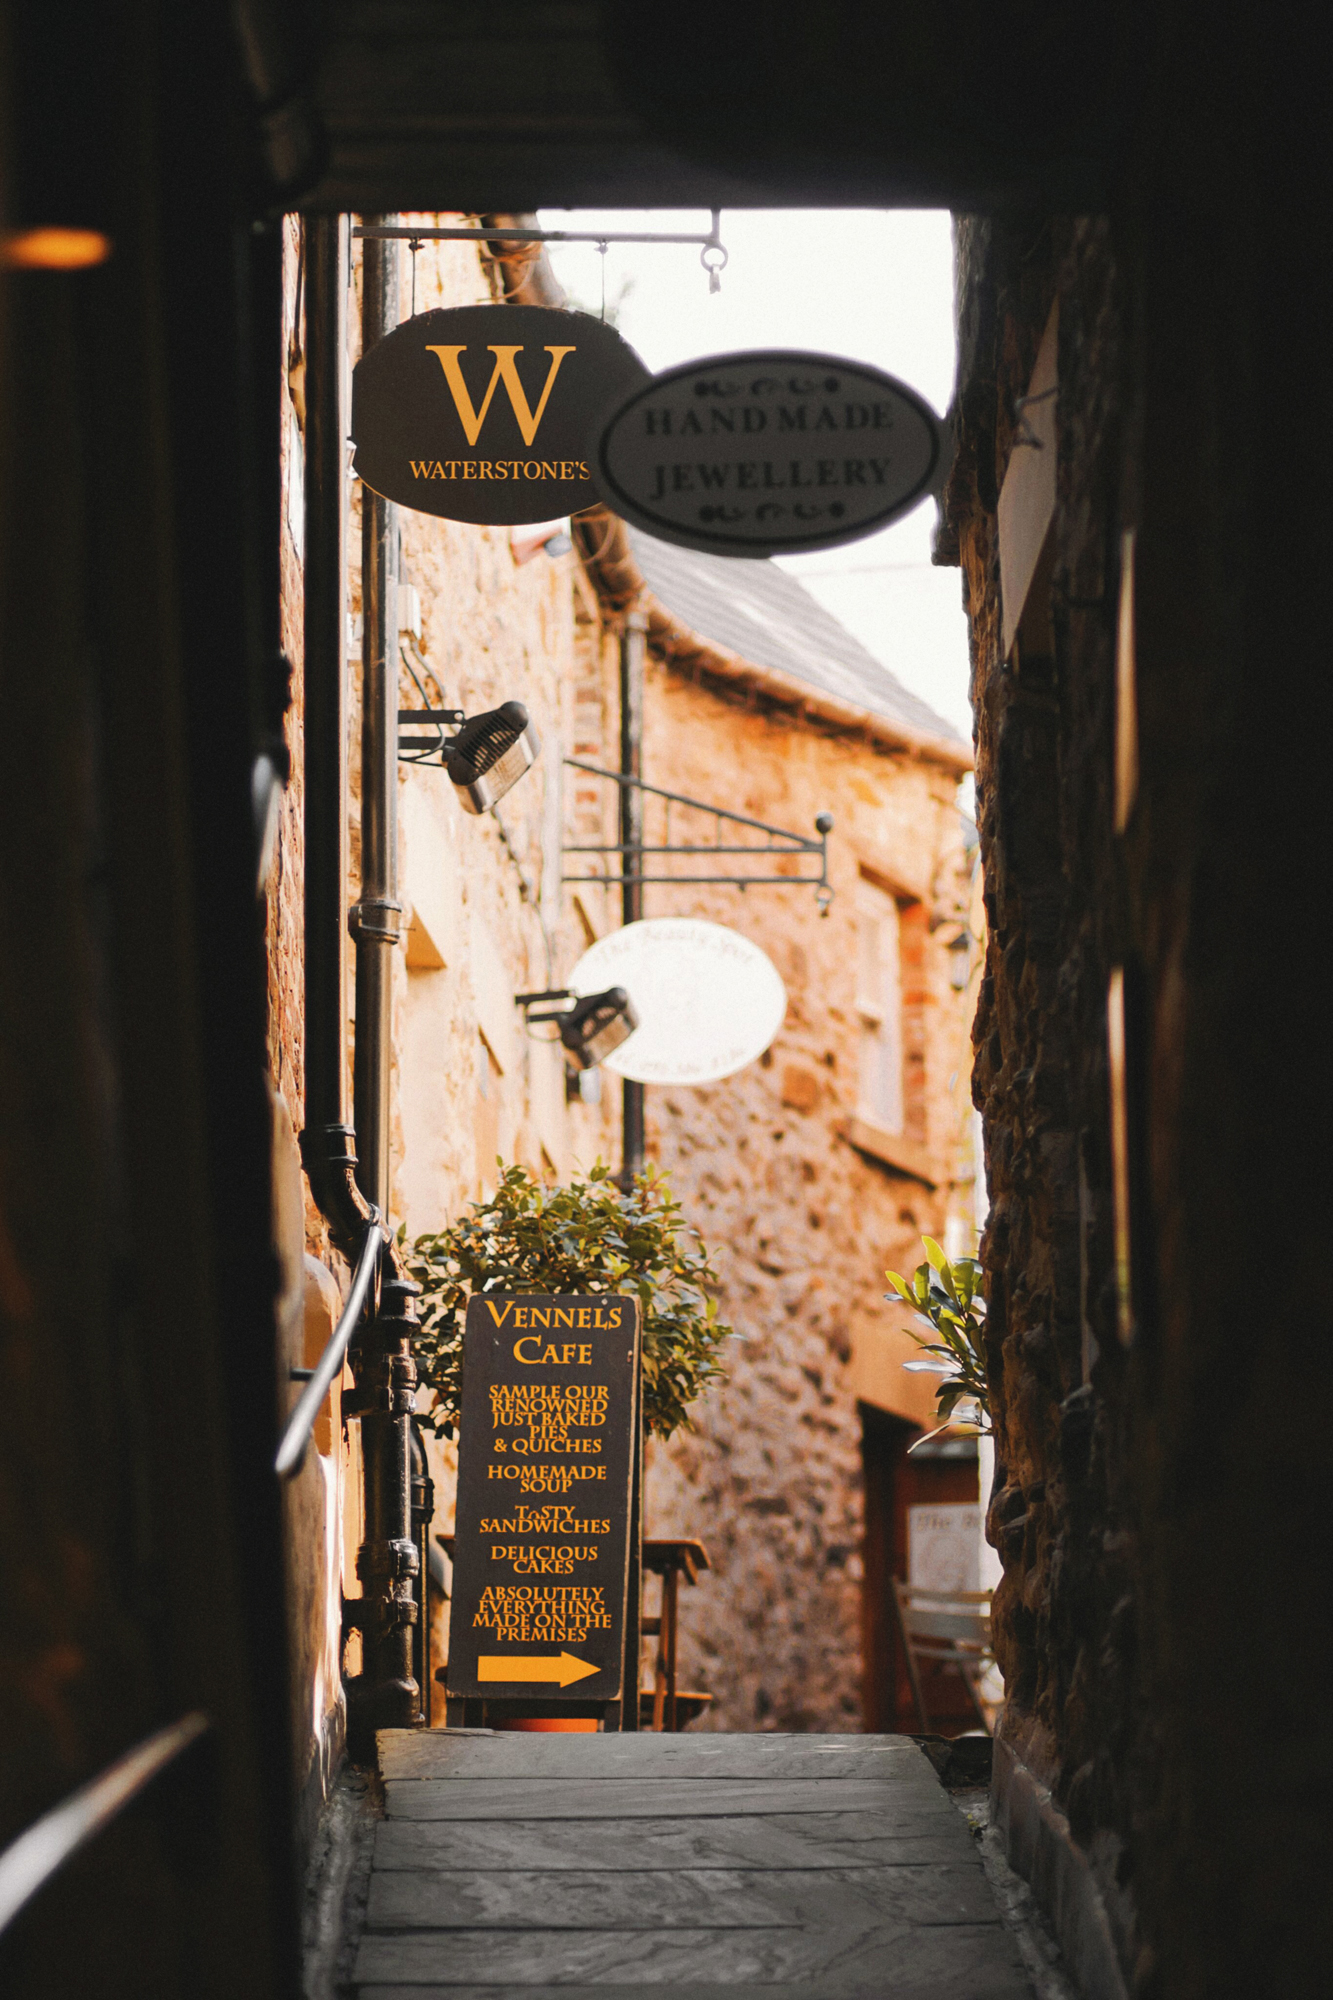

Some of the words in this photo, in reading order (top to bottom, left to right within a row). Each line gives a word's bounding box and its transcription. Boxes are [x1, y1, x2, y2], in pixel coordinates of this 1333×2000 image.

[425, 344, 577, 446] W
[408, 460, 591, 480] WATERSTONE'S
[649, 458, 892, 501] JEWELLERY
[513, 1334, 593, 1365] CAFE
[488, 1384, 561, 1400] SAMPLE
[564, 1385, 610, 1400] OUR
[491, 1399, 608, 1413] RENOWNED
[492, 1412, 537, 1429] JUST
[541, 1412, 606, 1427] BAKED
[529, 1425, 568, 1440] PIES
[493, 1438, 508, 1453] &
[511, 1438, 602, 1456] QUICHES
[487, 1464, 607, 1480] HOMEMADE
[520, 1478, 572, 1493] SOUP
[479, 1518, 611, 1534] SANDWICHES
[491, 1545, 598, 1561] DELICIOUS
[513, 1560, 574, 1575] CAKES
[481, 1586, 604, 1601] ABSOLUTELY
[479, 1600, 606, 1615] EVERYTHING
[472, 1613, 530, 1628] MADE
[534, 1614, 566, 1628] ON
[571, 1614, 612, 1629] THE
[496, 1627, 587, 1642] PREMISES
